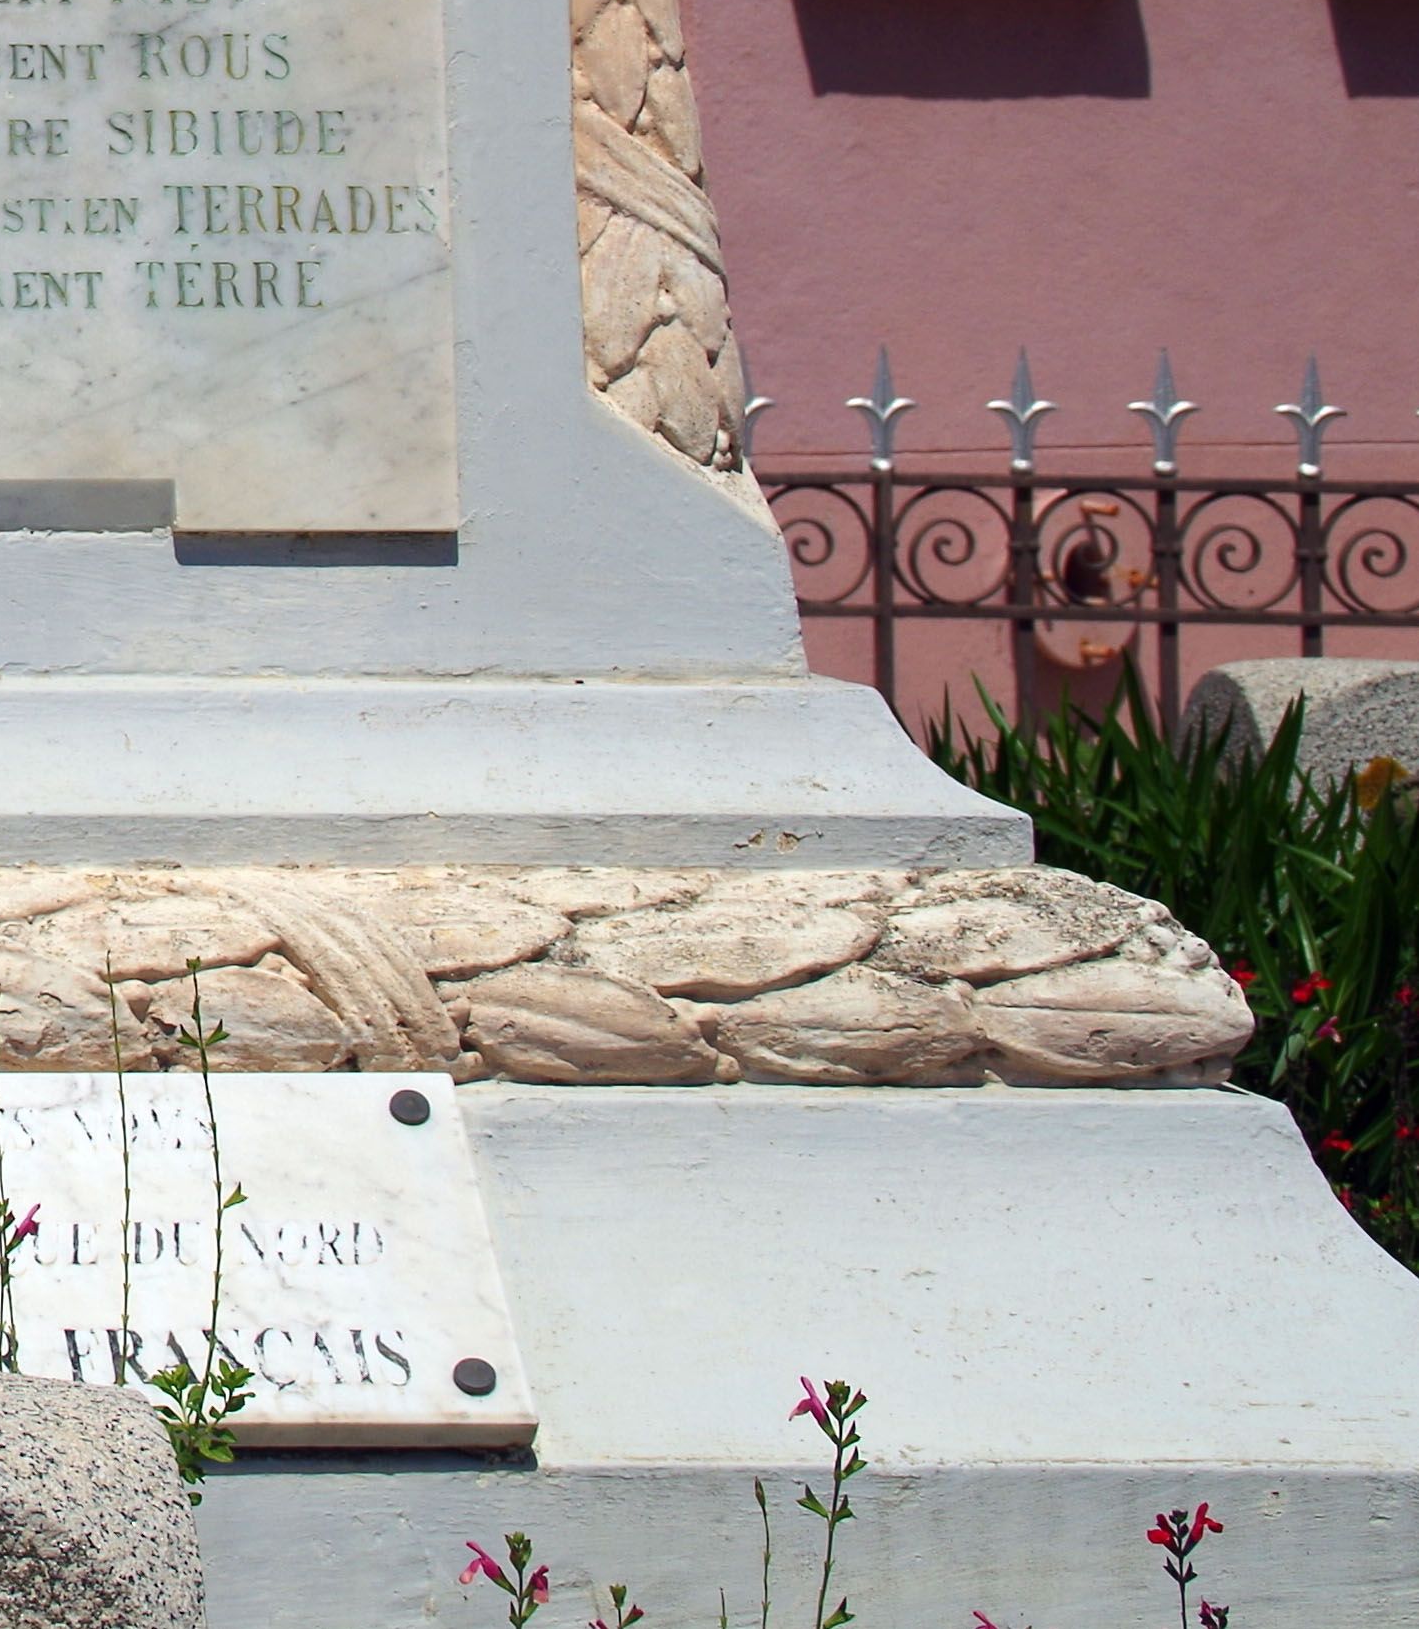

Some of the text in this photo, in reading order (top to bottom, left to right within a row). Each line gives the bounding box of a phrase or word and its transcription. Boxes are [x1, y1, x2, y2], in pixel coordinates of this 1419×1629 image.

[137, 34, 292, 81] ROUS
[107, 109, 348, 156] SIBIUDE
[163, 185, 438, 236] TERRADES
[133, 1220, 202, 1266] DU
[240, 1220, 385, 1267] NORD
[63, 1327, 411, 1391] FRANÇAIS
